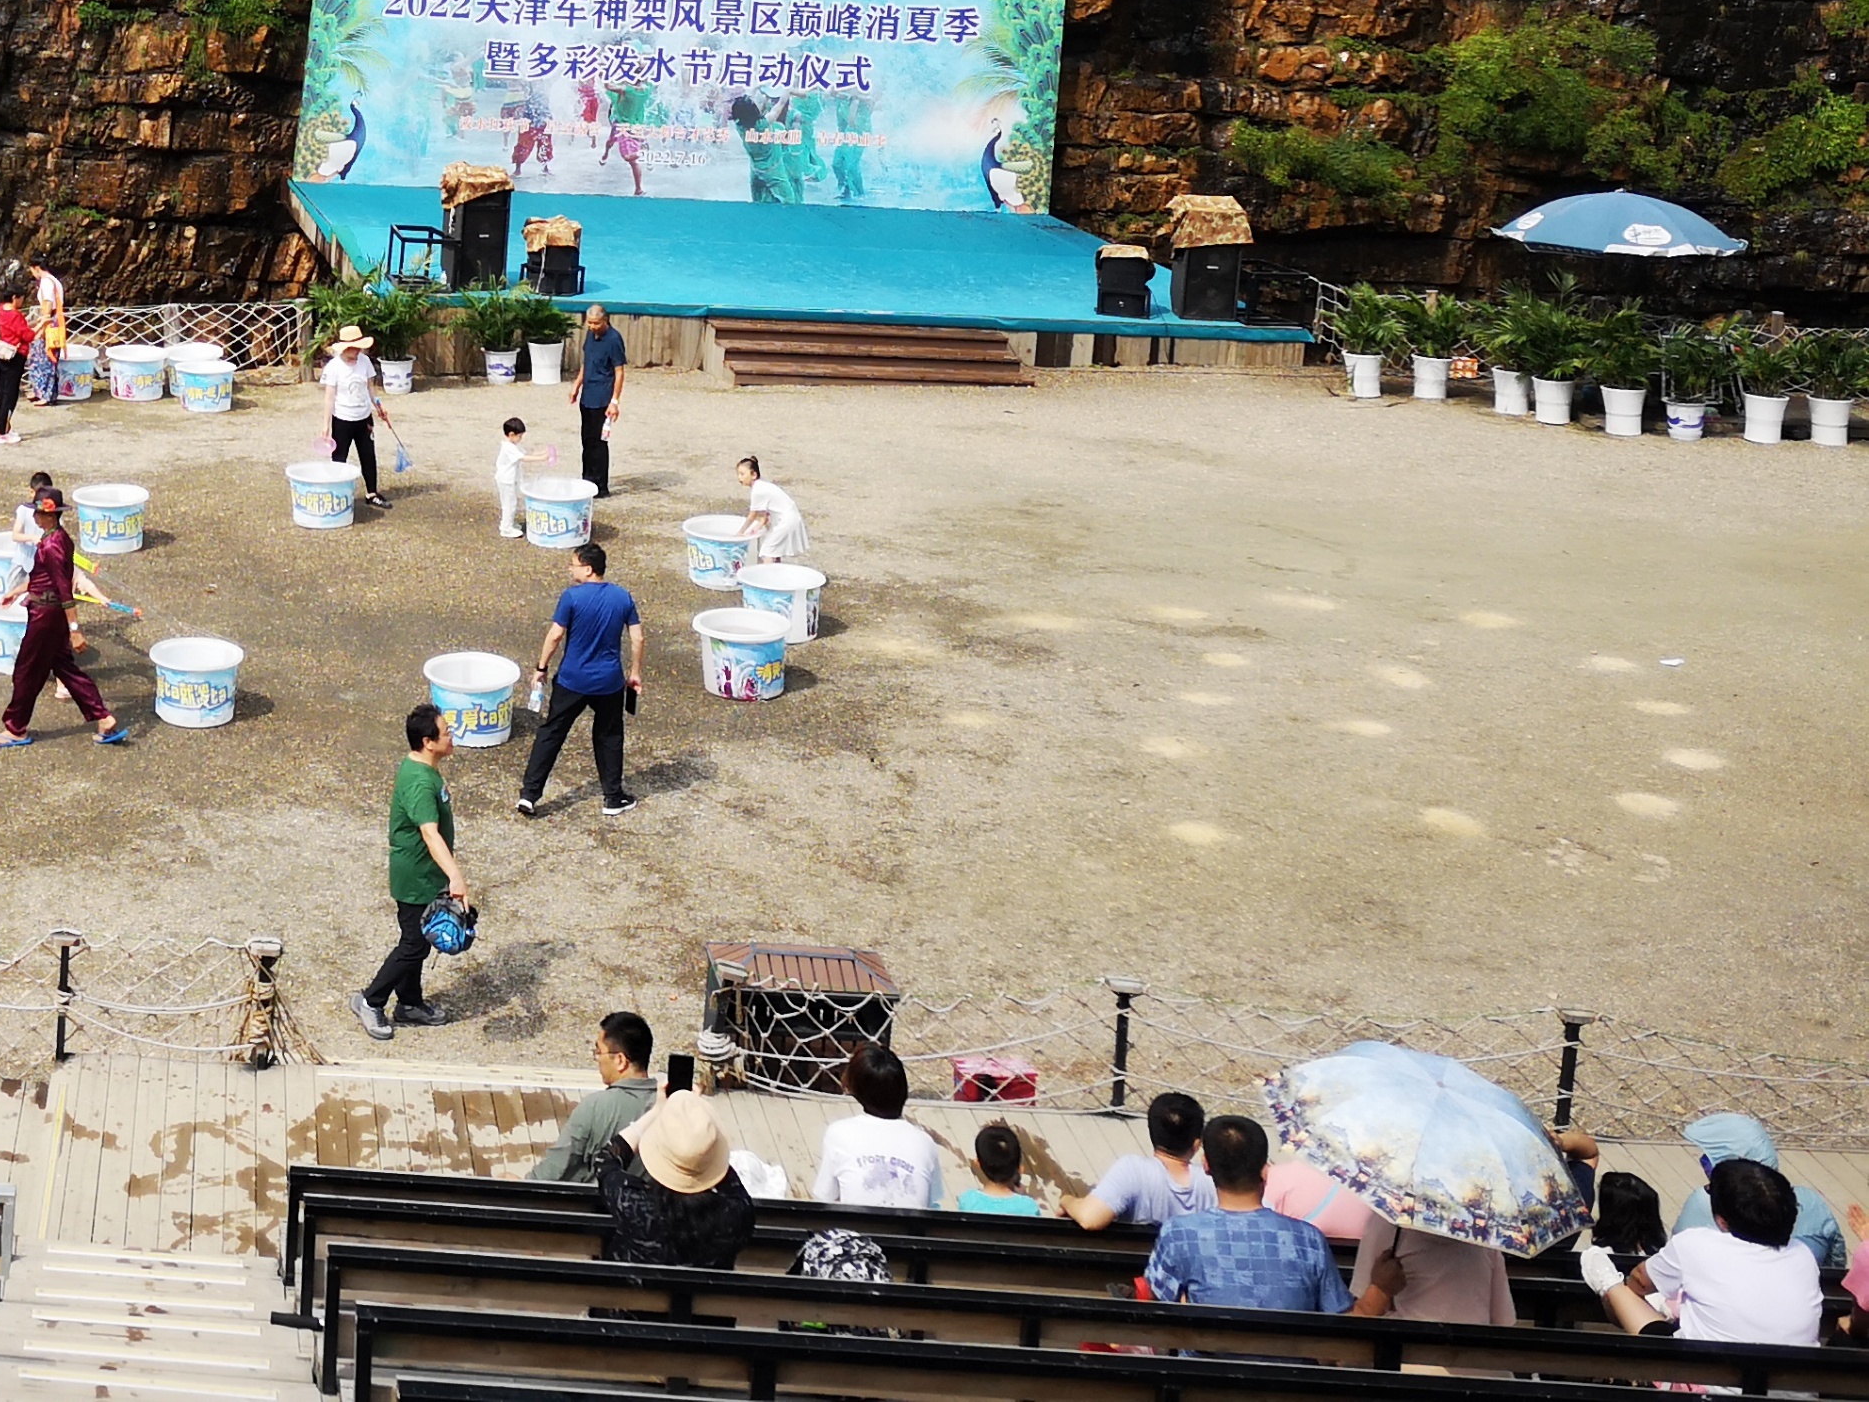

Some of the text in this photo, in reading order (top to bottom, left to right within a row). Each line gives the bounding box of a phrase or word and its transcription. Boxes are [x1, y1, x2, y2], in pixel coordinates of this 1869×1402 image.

[484, 41, 872, 92] 暨多彩泼水节启动仪式
[638, 150, 706, 165] 2022.7.16
